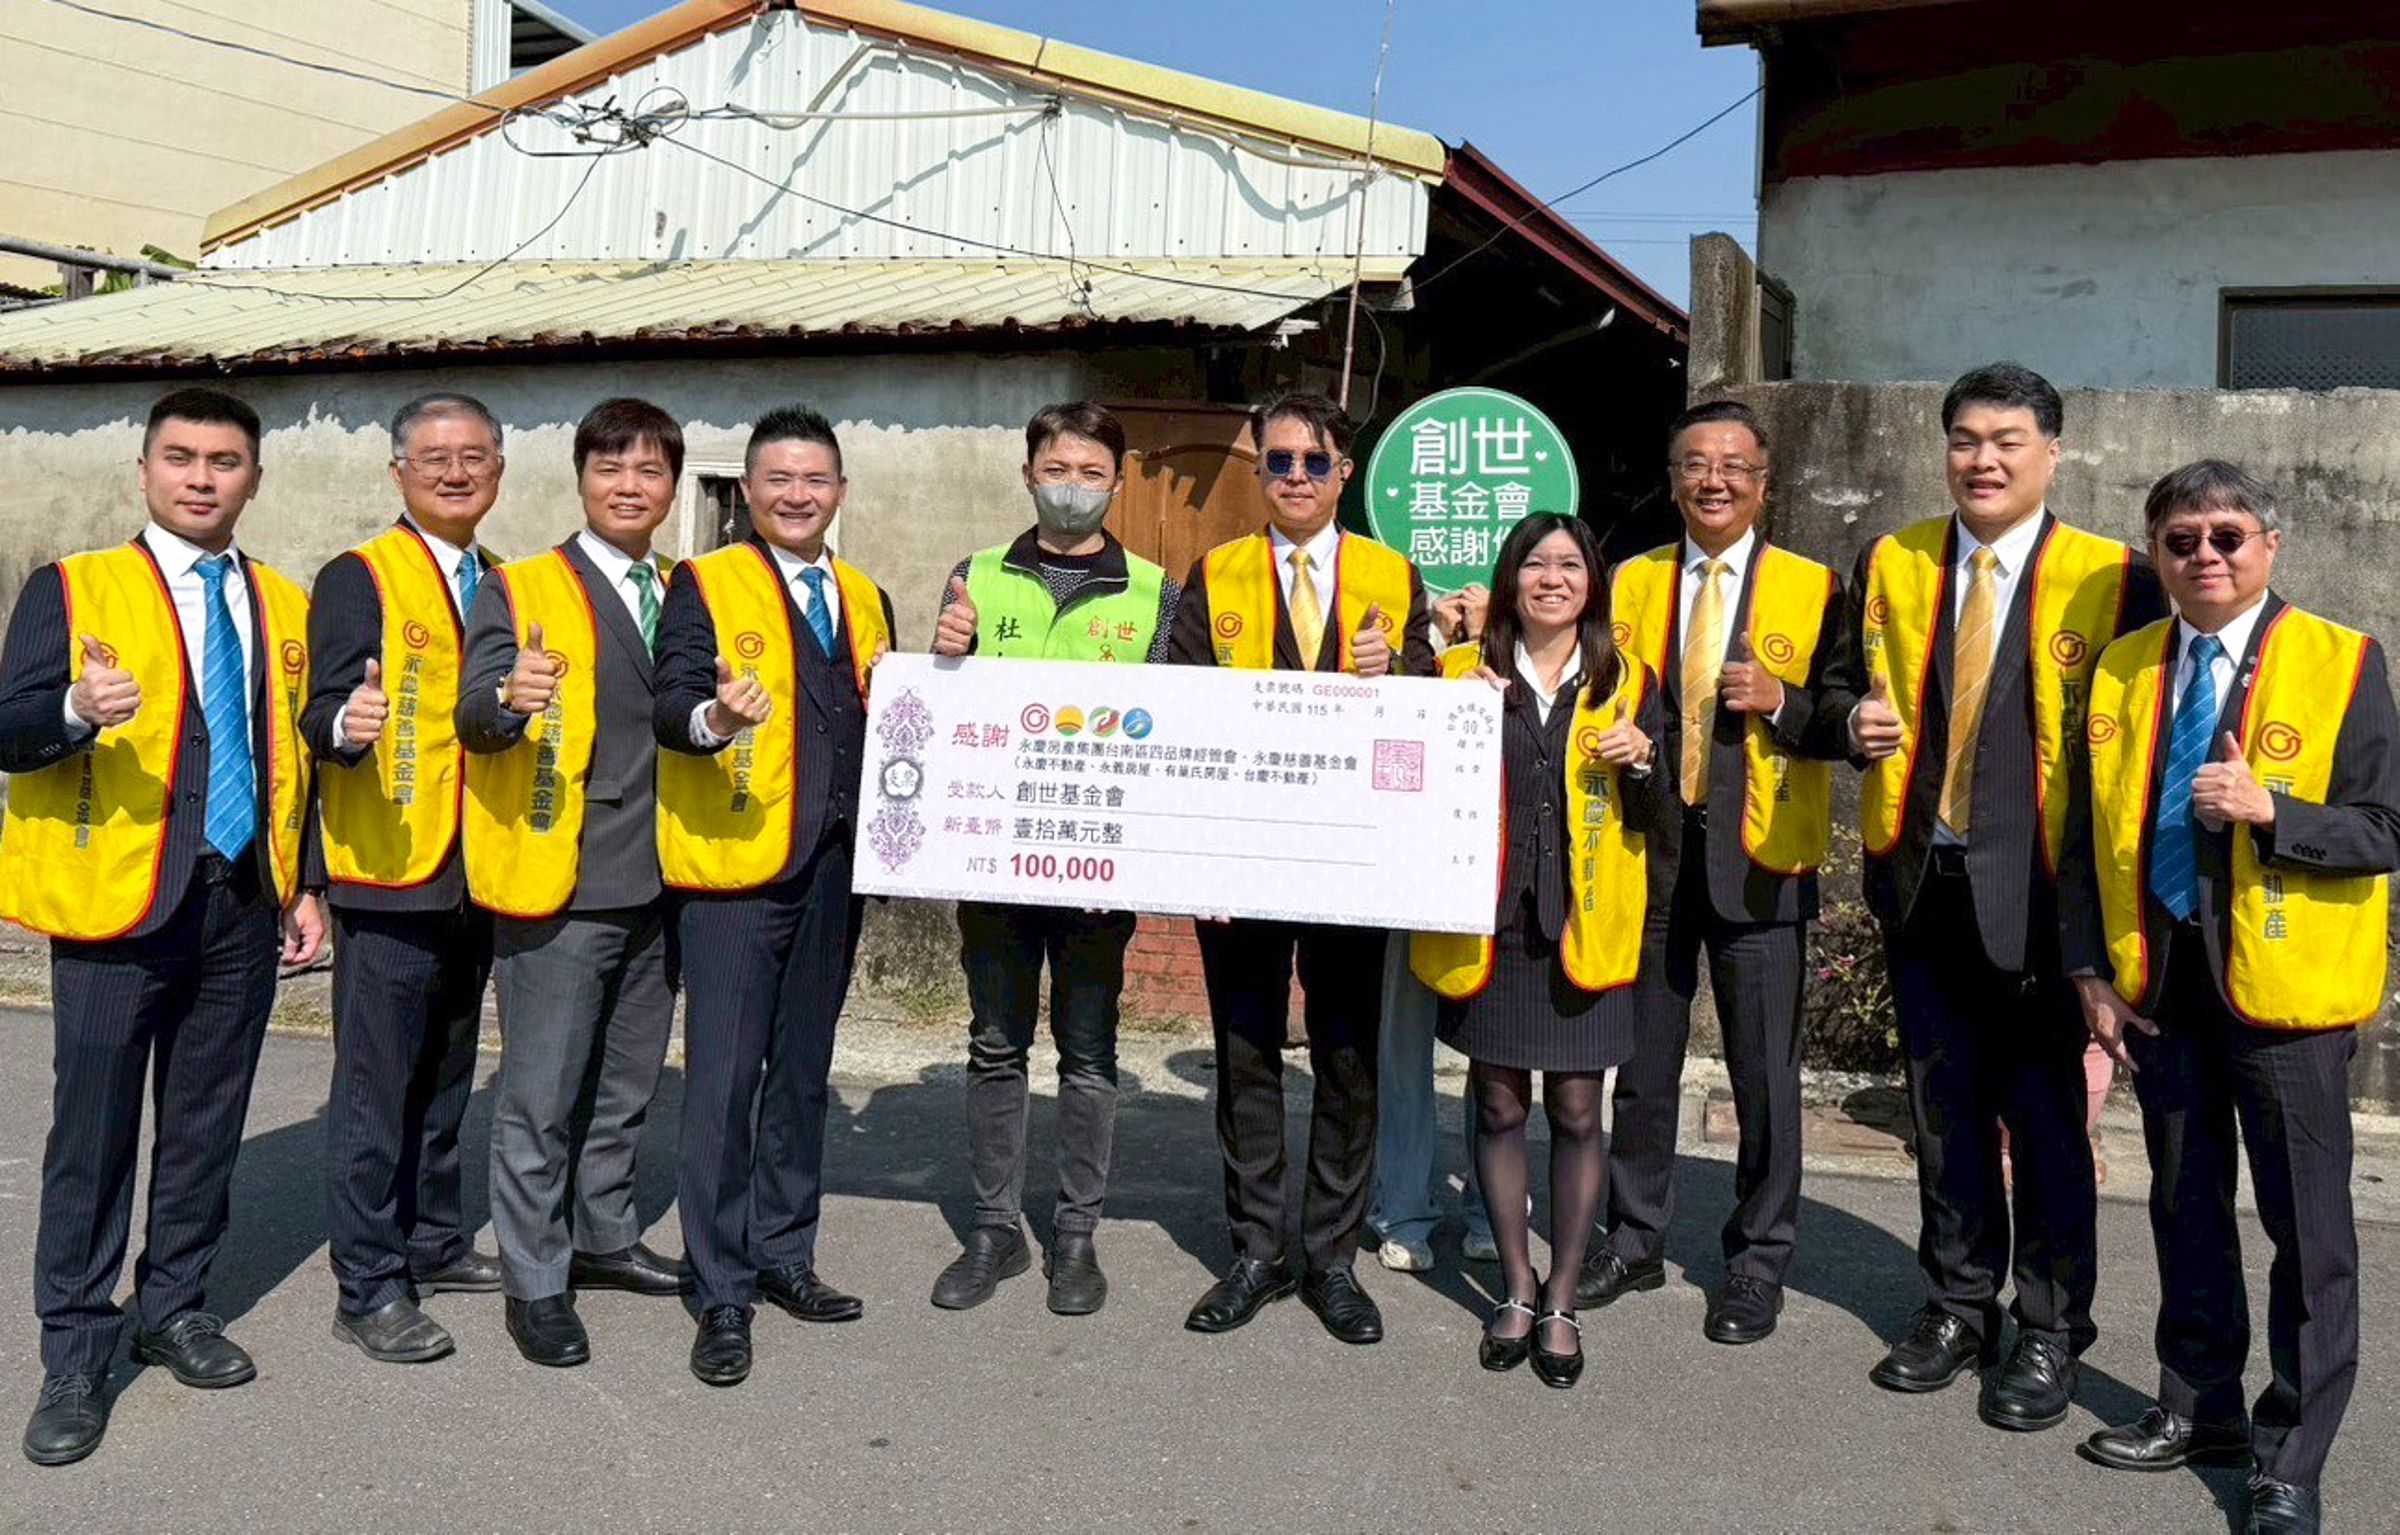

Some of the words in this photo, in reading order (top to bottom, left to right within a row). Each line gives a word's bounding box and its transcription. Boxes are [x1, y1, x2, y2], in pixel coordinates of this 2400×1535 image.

[1411, 417, 1532, 475] 創世
[1409, 481, 1532, 521] 基金會
[1410, 526, 1507, 566] 感謝
[1087, 615, 1138, 642] 創世
[1307, 704, 1328, 716] 115
[951, 721, 1011, 749] 感謝
[947, 780, 1006, 800] 受款人
[1016, 780, 1125, 807] 創世基金會
[1013, 817, 1124, 845] 壹拾萬元整
[966, 857, 998, 874] NT$
[1010, 853, 1115, 884] 100,000
